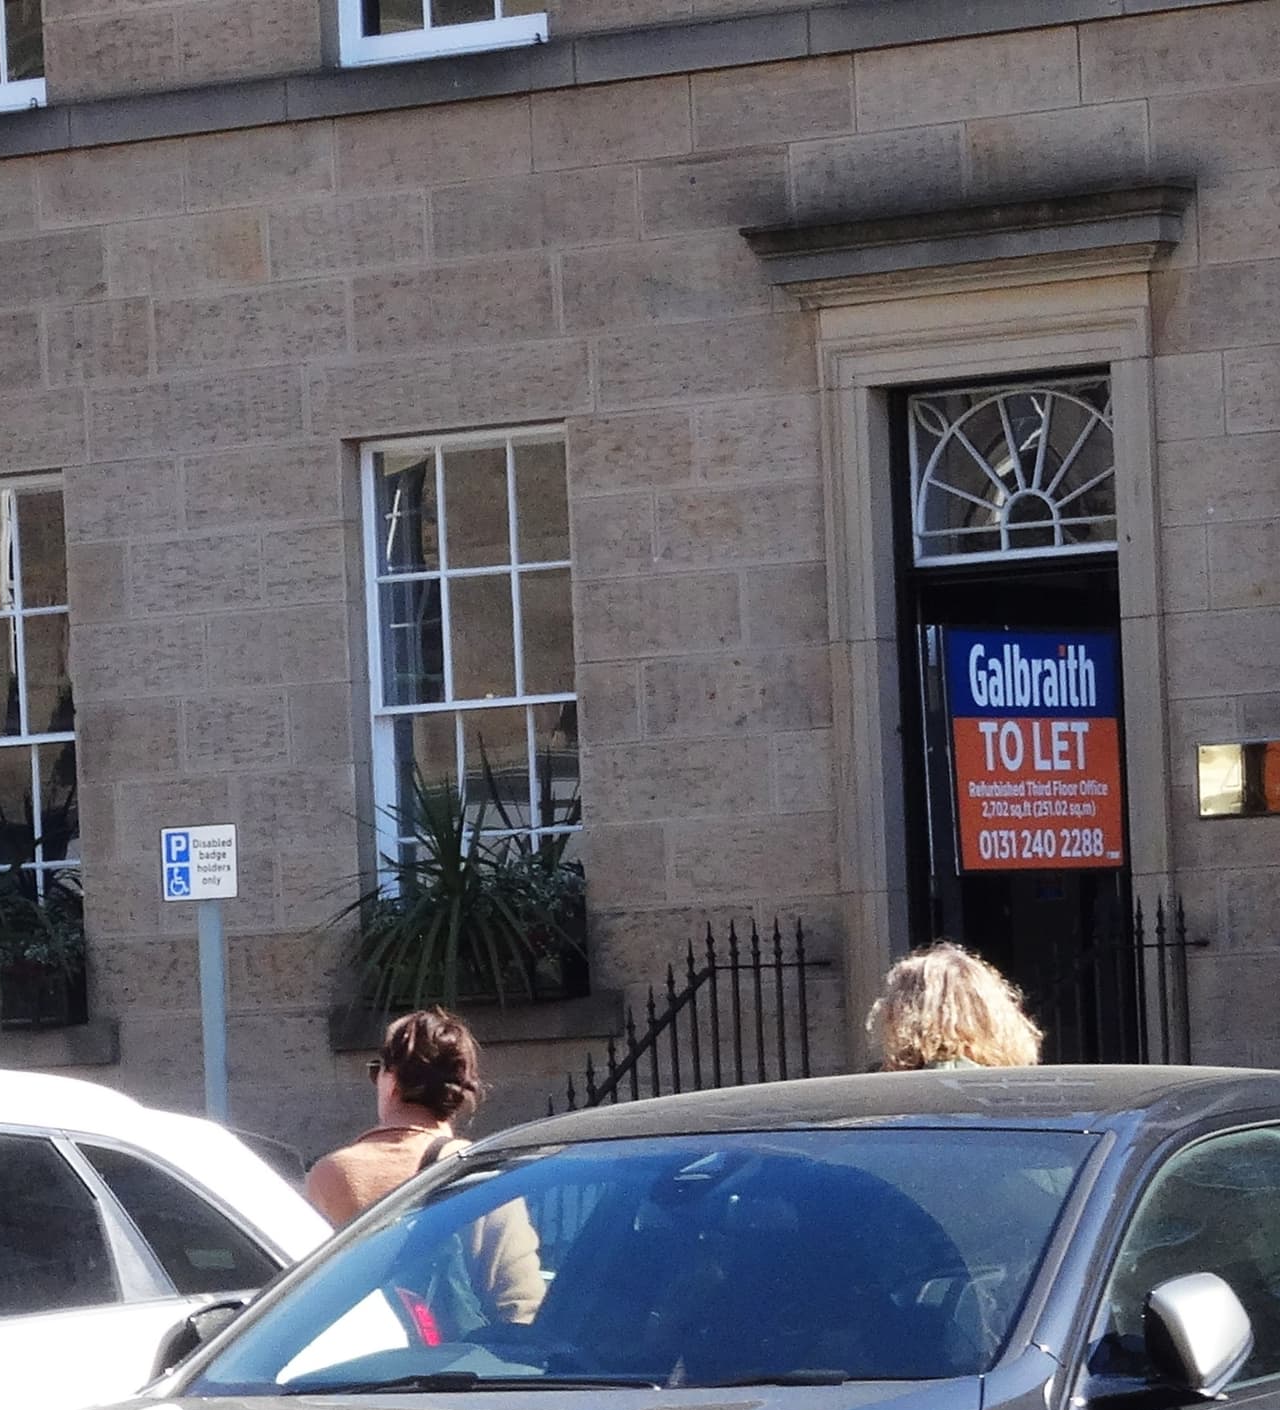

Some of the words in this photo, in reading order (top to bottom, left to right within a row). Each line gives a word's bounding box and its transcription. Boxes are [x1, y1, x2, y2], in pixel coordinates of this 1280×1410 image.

[969, 643, 1097, 708] Galbraith
[978, 720, 1024, 772] TO
[1032, 721, 1090, 771] LET
[968, 780, 1025, 798] Refurbished
[1026, 780, 1051, 797] Third
[1052, 780, 1078, 796] Floor
[1079, 779, 1109, 796] Office
[171, 835, 187, 861] P
[192, 838, 233, 849] Disabled
[979, 829, 1017, 860] 0131
[1021, 828, 1056, 859] 240
[1060, 827, 1104, 858] 2288
[199, 850, 227, 861] badge
[197, 863, 231, 873] holders
[202, 875, 222, 886] only
